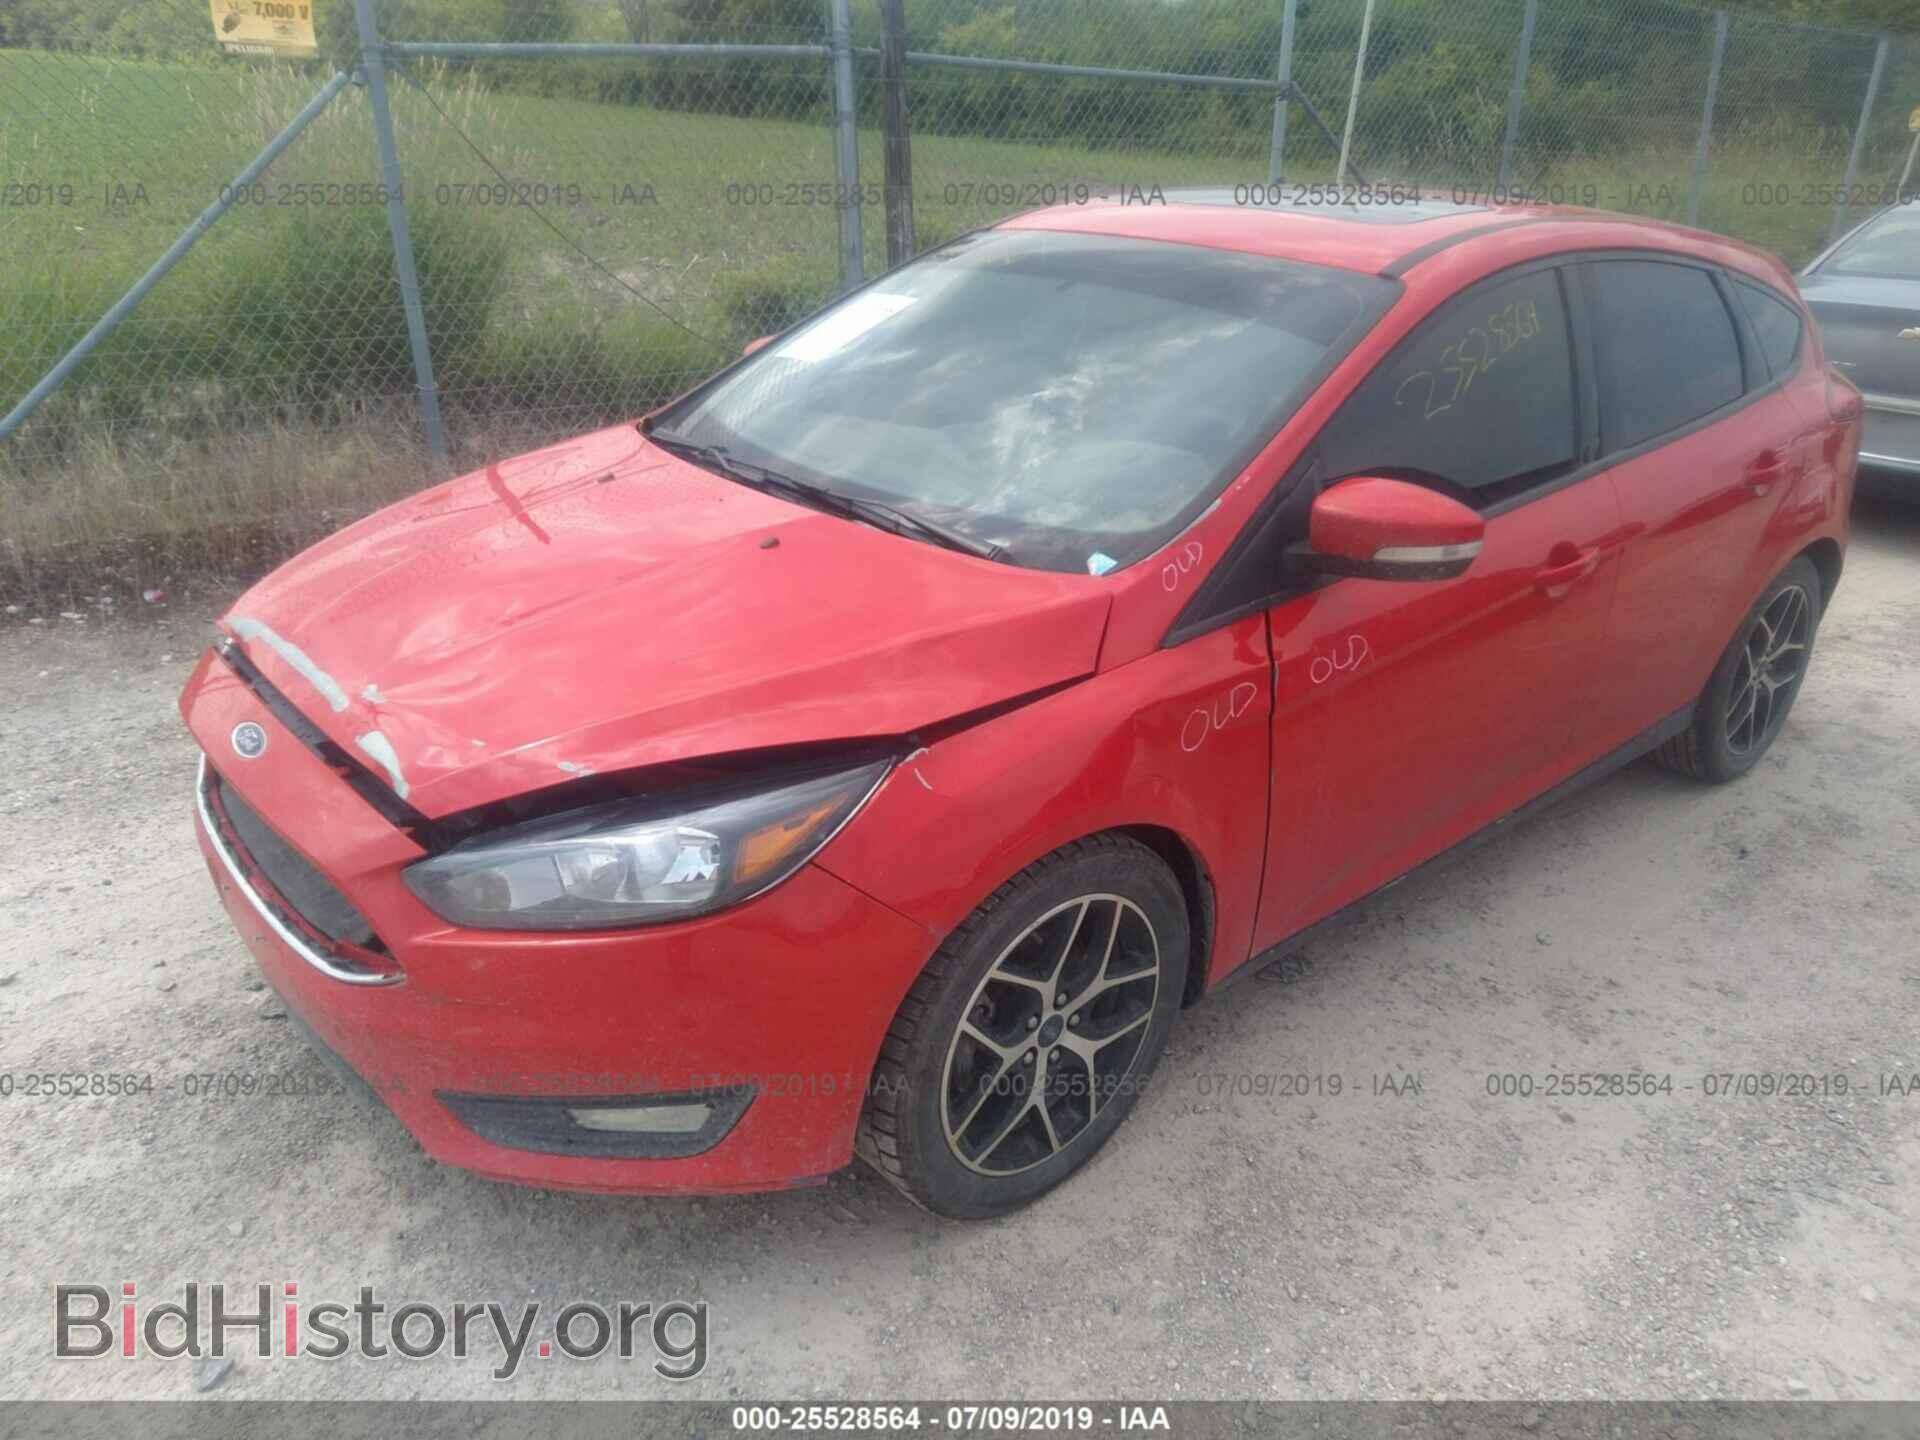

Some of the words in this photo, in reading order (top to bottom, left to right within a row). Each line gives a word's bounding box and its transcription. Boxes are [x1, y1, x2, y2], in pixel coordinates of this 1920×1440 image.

[252, 1, 295, 20] 7,000
[1162, 541, 1203, 592] OLD
[1310, 634, 1369, 684] OLD
[1181, 681, 1257, 752] OLD
